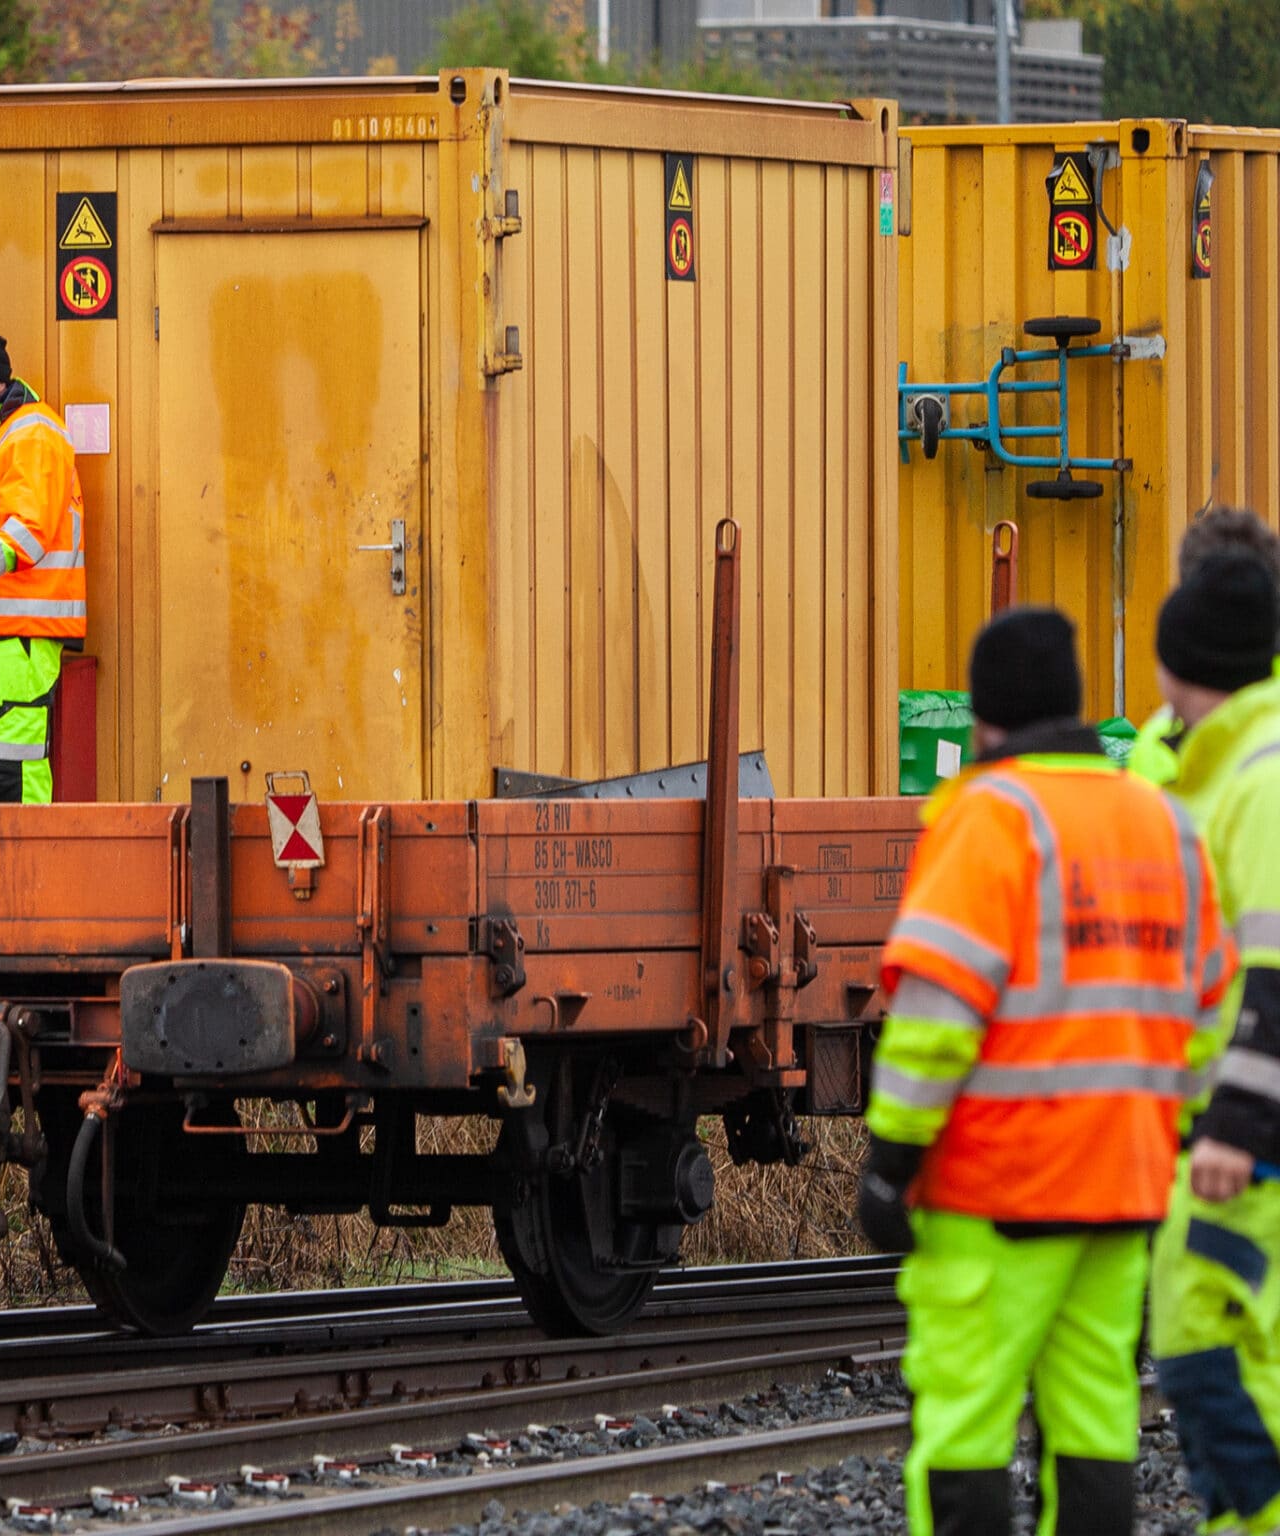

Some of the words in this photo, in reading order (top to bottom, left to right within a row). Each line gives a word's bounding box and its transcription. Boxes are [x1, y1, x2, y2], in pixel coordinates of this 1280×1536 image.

[535, 803, 549, 832] 23
[553, 803, 571, 832] RIV
[534, 839, 548, 870] 85
[552, 839, 612, 869] CH-WASCO
[535, 880, 560, 909] 3301
[565, 879, 596, 909] 371-6
[536, 918, 550, 948] Ks
